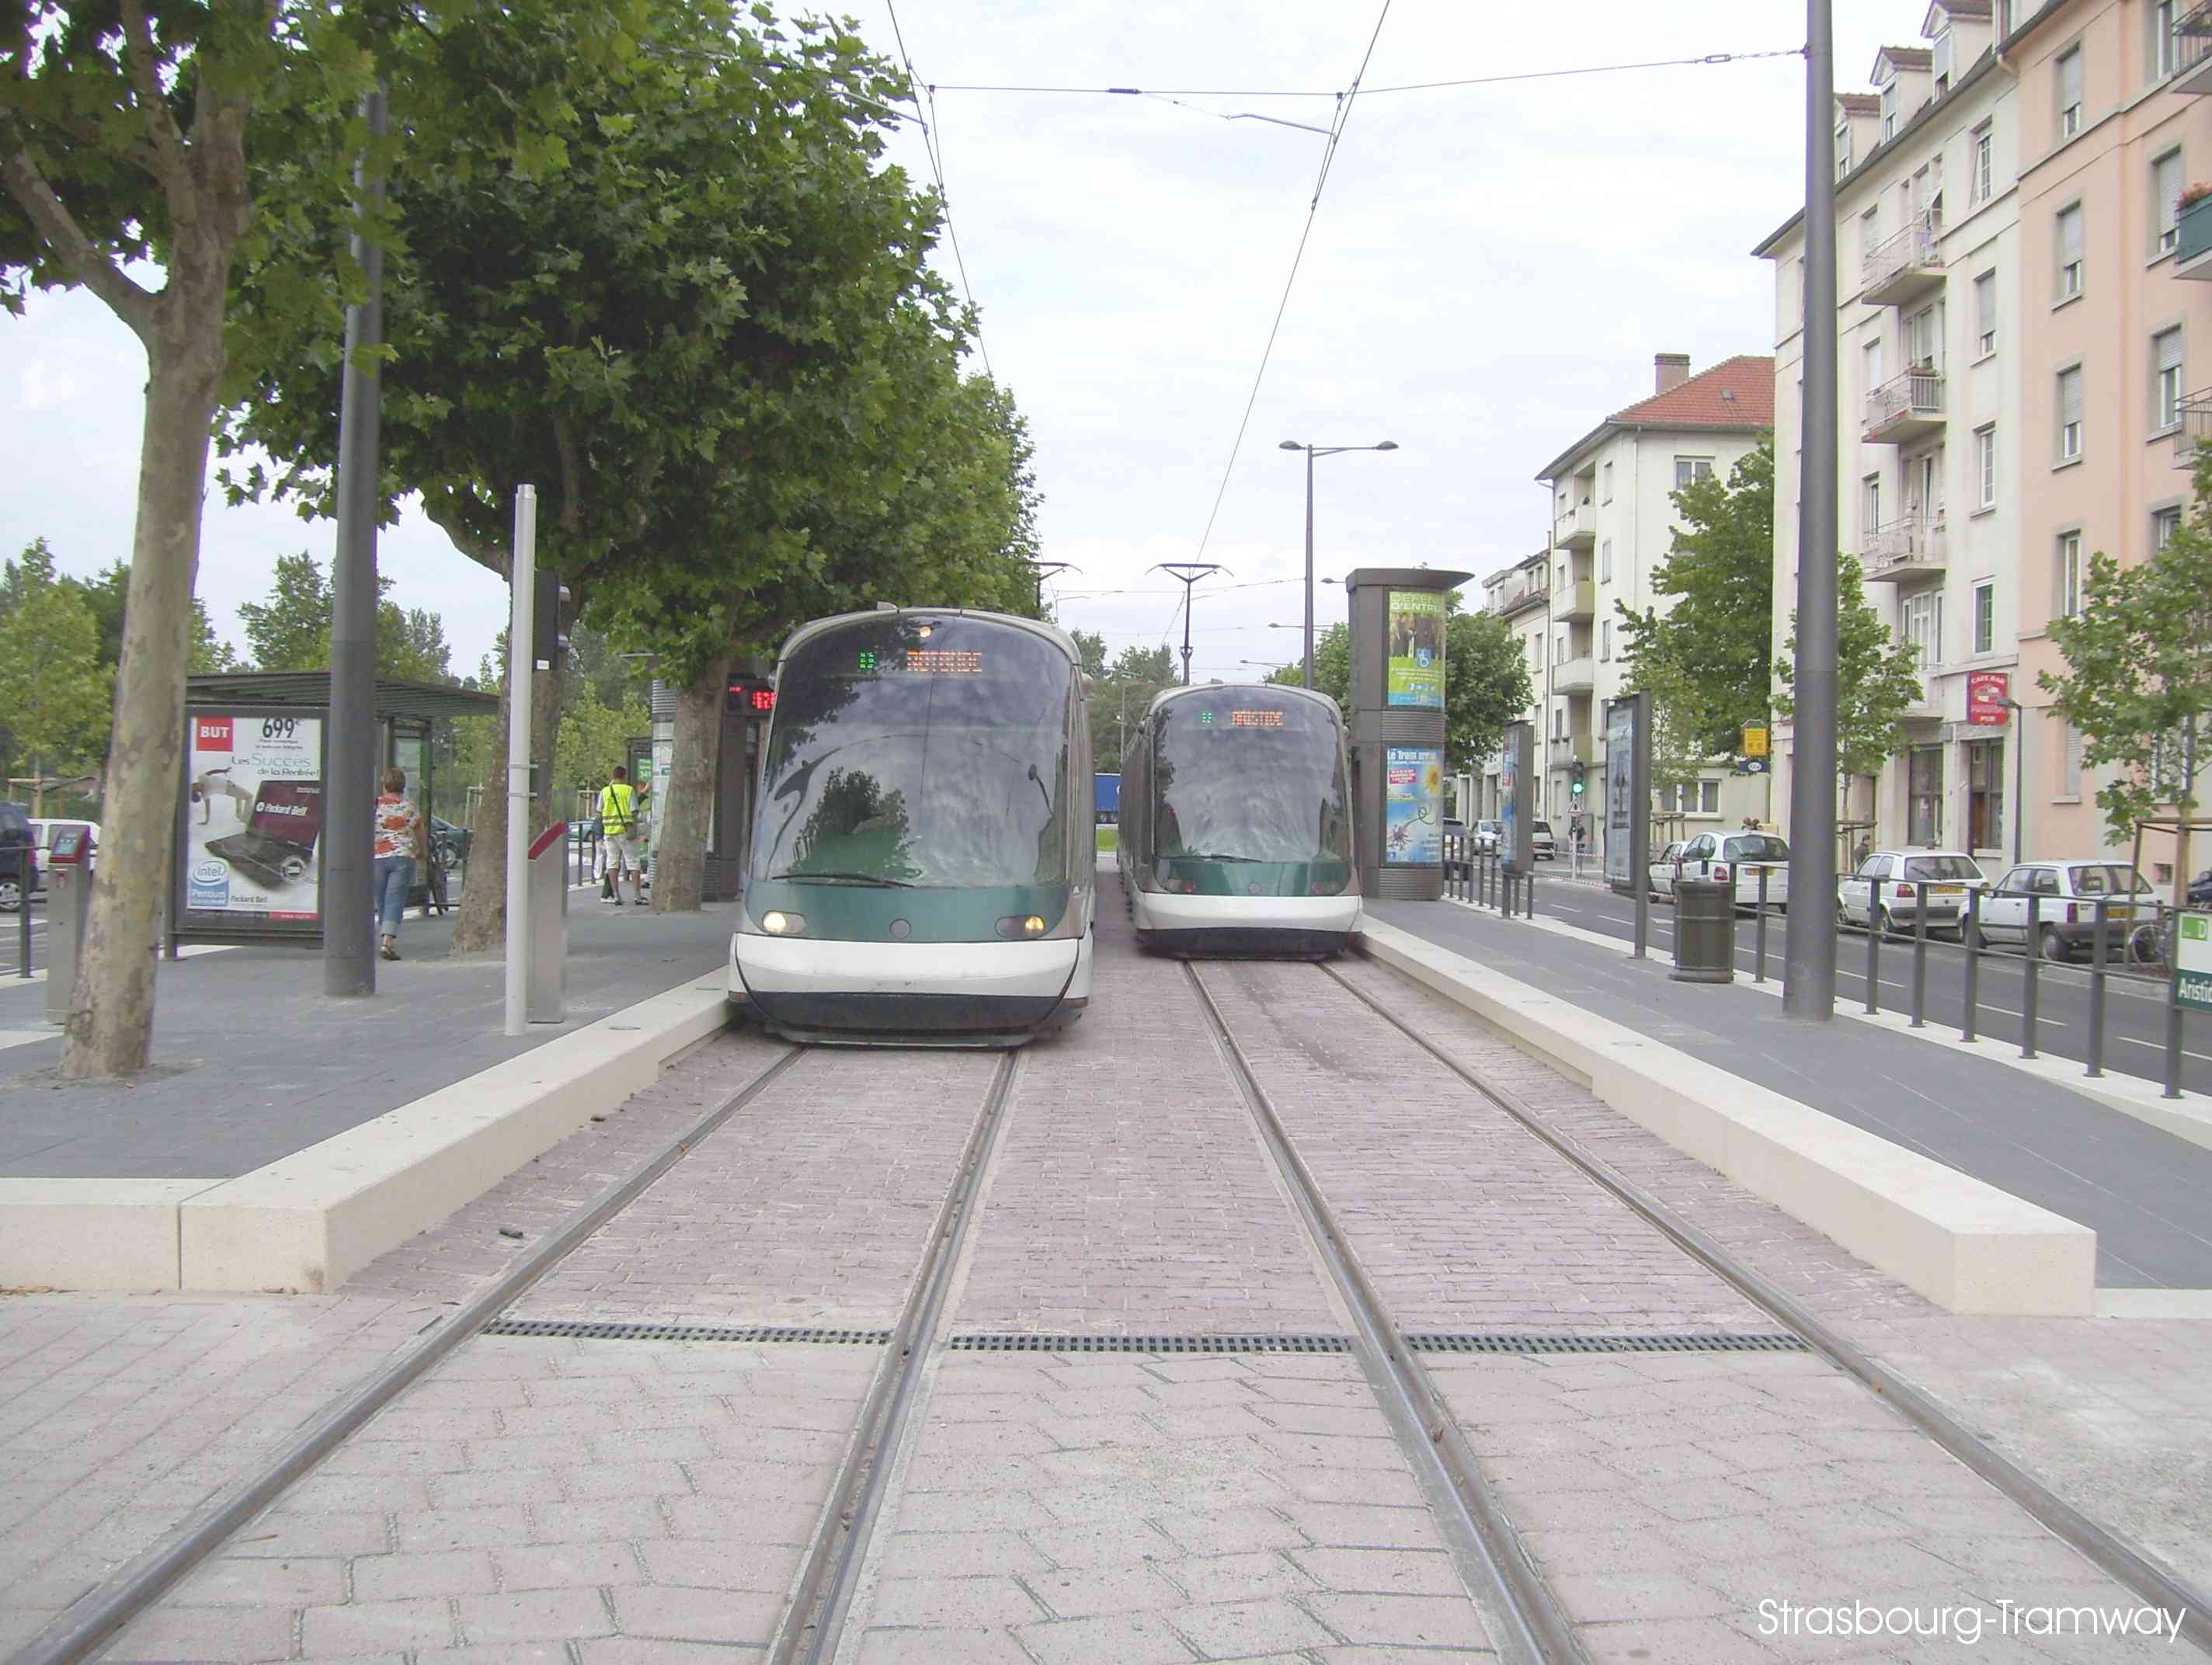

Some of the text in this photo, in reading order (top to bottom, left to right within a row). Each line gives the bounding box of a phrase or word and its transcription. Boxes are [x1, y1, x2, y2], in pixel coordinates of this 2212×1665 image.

[200, 726, 230, 738] BUT
[231, 756, 249, 765] Les
[198, 864, 223, 876] intel
